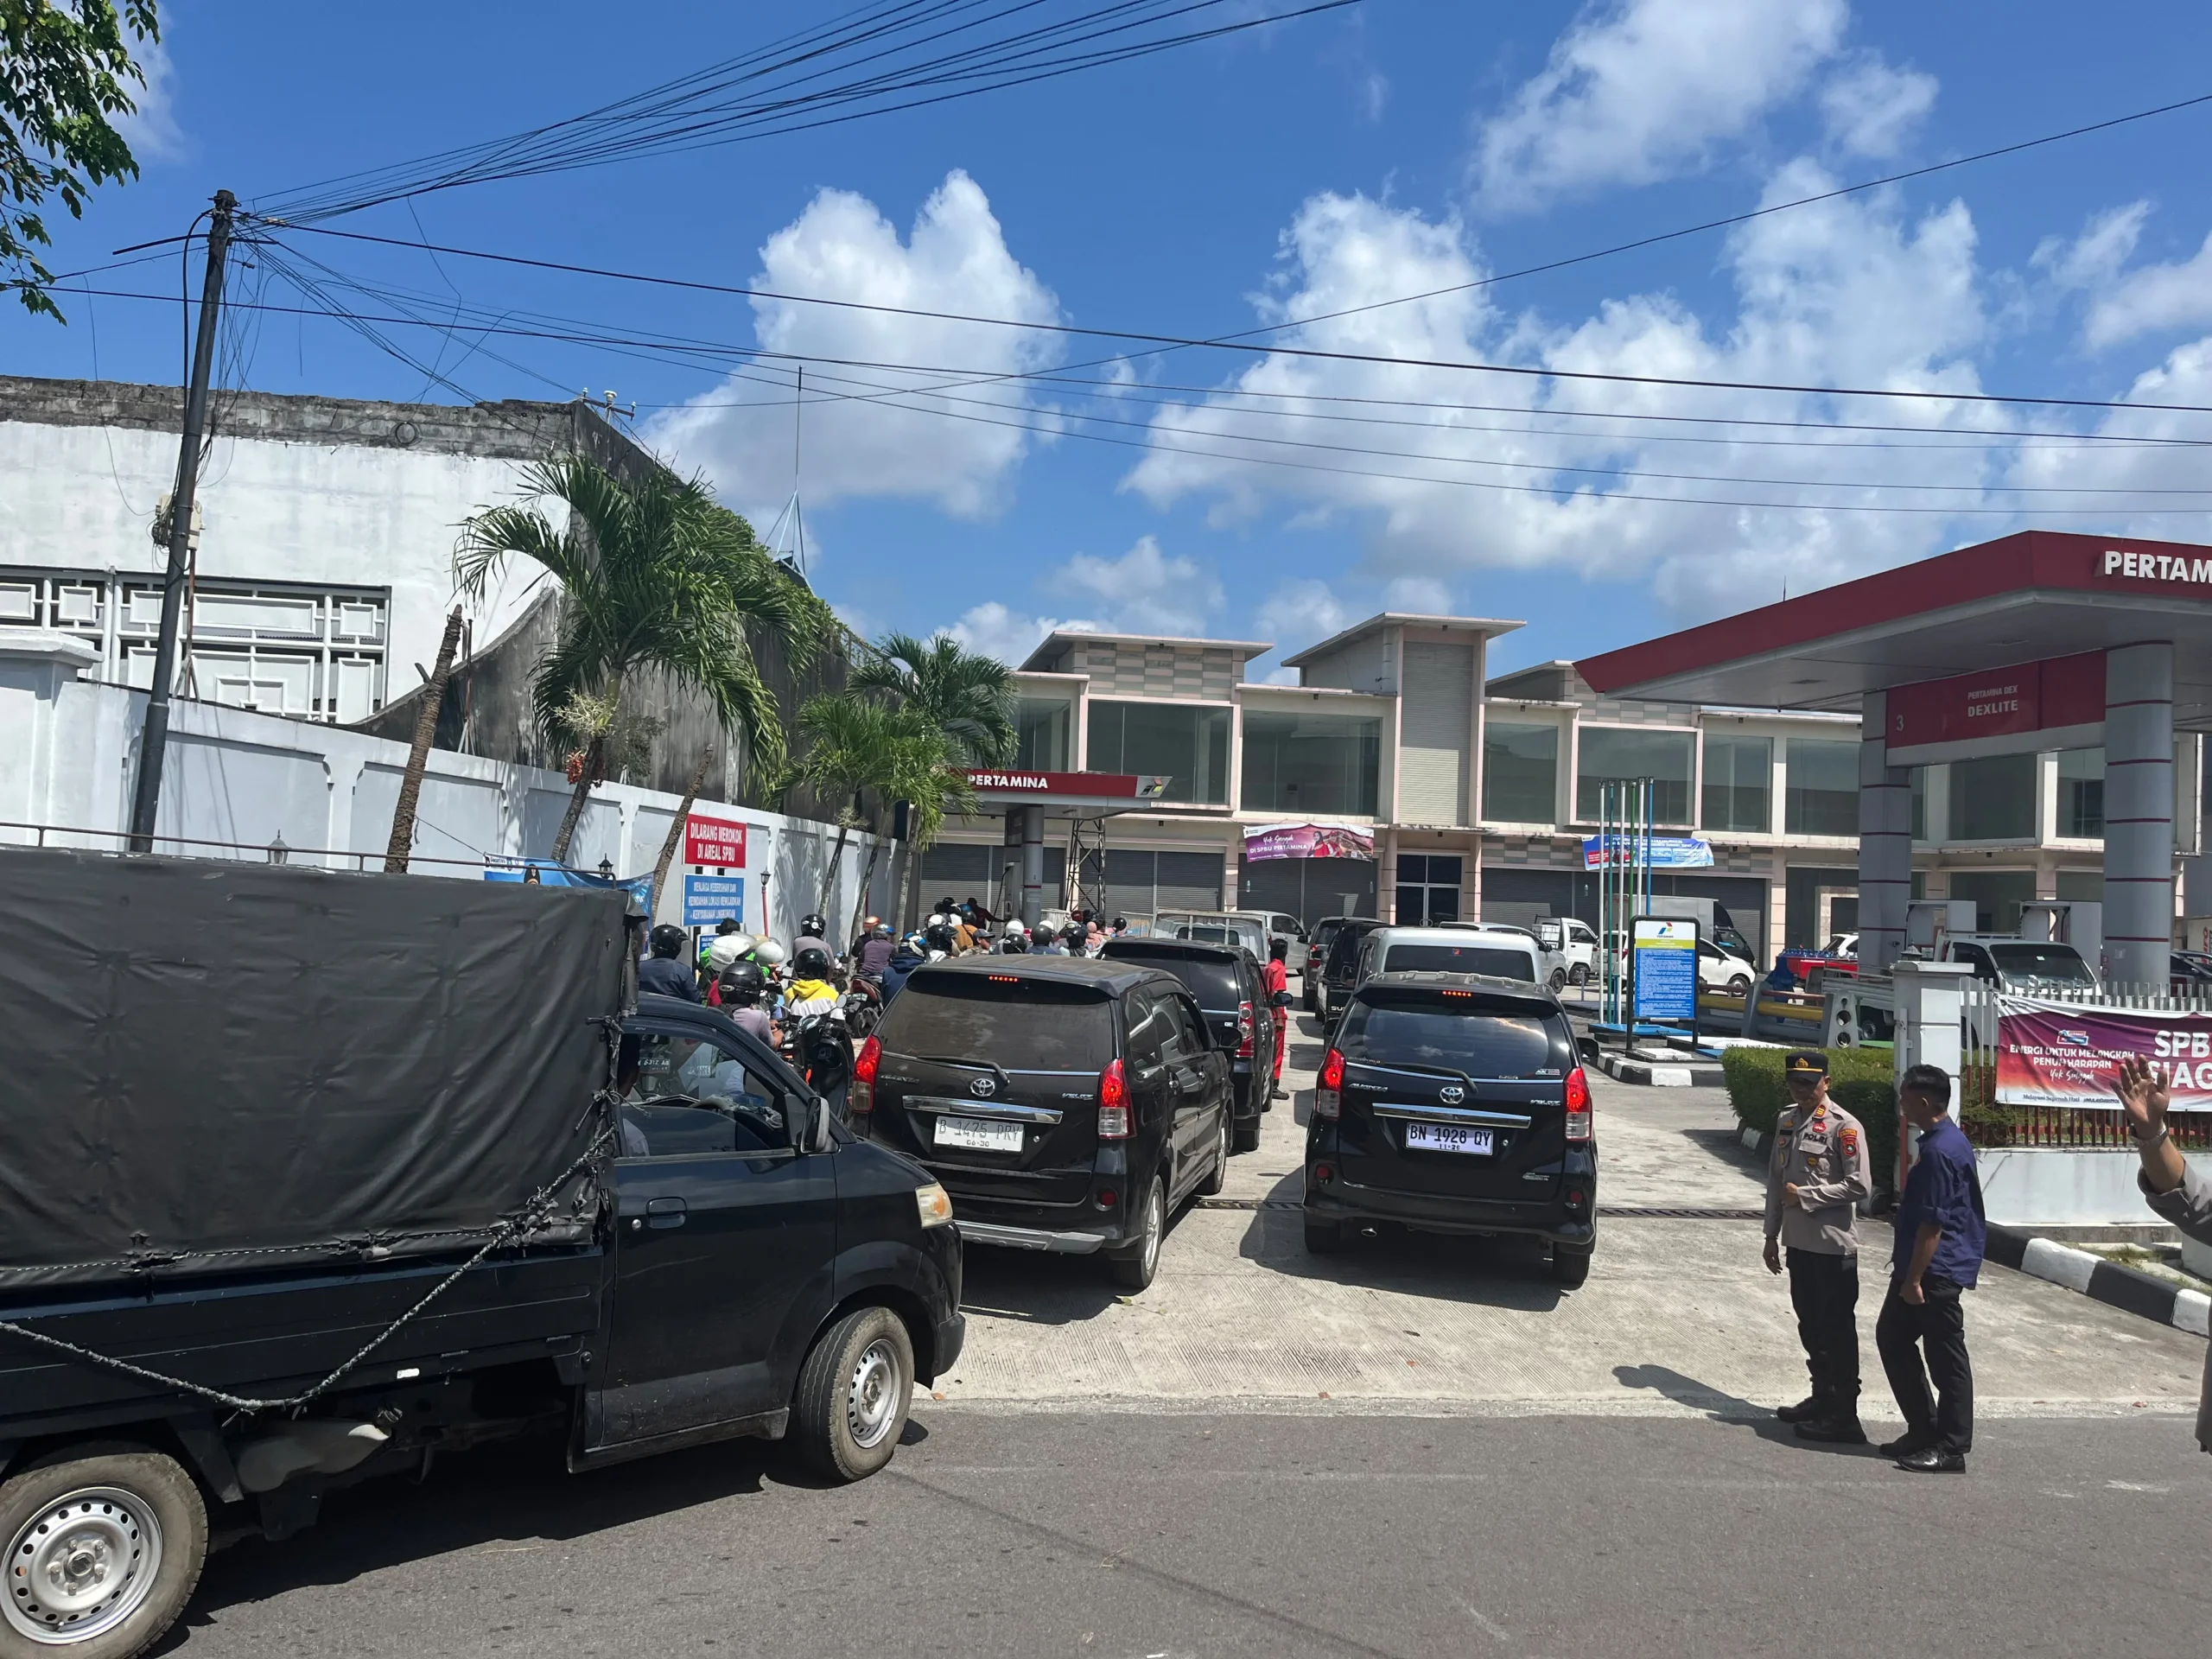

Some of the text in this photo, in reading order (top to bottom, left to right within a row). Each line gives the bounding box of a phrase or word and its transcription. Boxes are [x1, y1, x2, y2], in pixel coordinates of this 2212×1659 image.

[2105, 550, 2212, 584] PERTAM
[1967, 685, 2018, 701] PERTAMINA DEX
[1967, 700, 2018, 717] DEXLITE
[1896, 715, 1904, 731] 3
[967, 774, 1048, 789] PERTAMINA
[690, 823, 742, 844] DILARANG MEROKOK
[697, 842, 735, 862] DI AREAL SPBU
[2010, 1044, 2134, 1060] ENERGI UNTUK MELANGKAH
[2154, 1030, 2210, 1058] SPB
[2033, 1057, 2112, 1070] PENUH HARAPAN
[2050, 1069, 2063, 1082] Yuk
[1348, 1083, 1389, 1092] AVANZA
[938, 1119, 1020, 1142] B 1475 PRY
[1410, 1124, 1491, 1147] BN 1928 QY
[1803, 1133, 1827, 1144] POLRI
